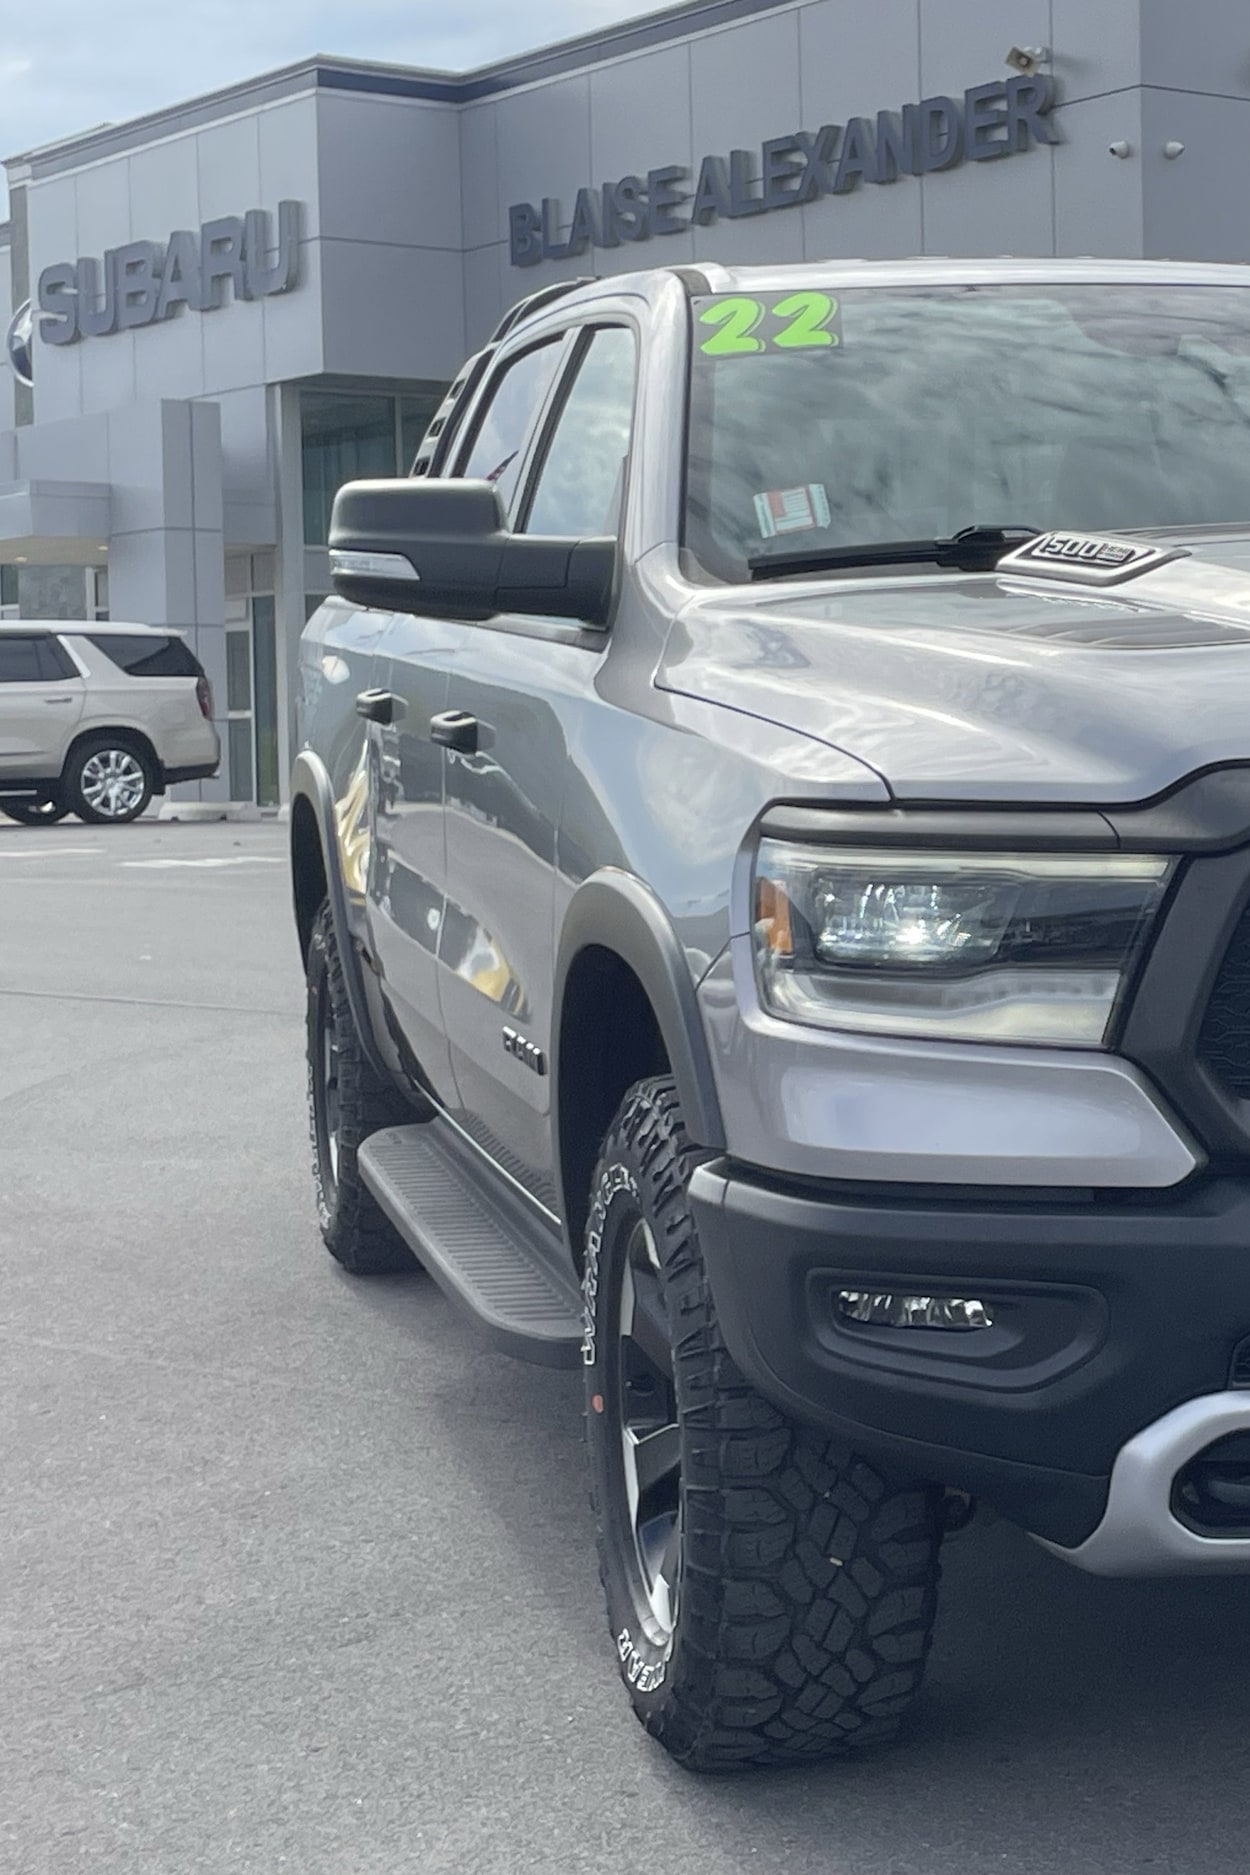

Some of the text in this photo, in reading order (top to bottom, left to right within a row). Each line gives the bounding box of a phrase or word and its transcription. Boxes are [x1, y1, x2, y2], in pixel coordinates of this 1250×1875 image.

[509, 73, 1062, 267] BLAISE ALEXANDER
[38, 200, 304, 346] SUBARU
[699, 290, 840, 357] 22
